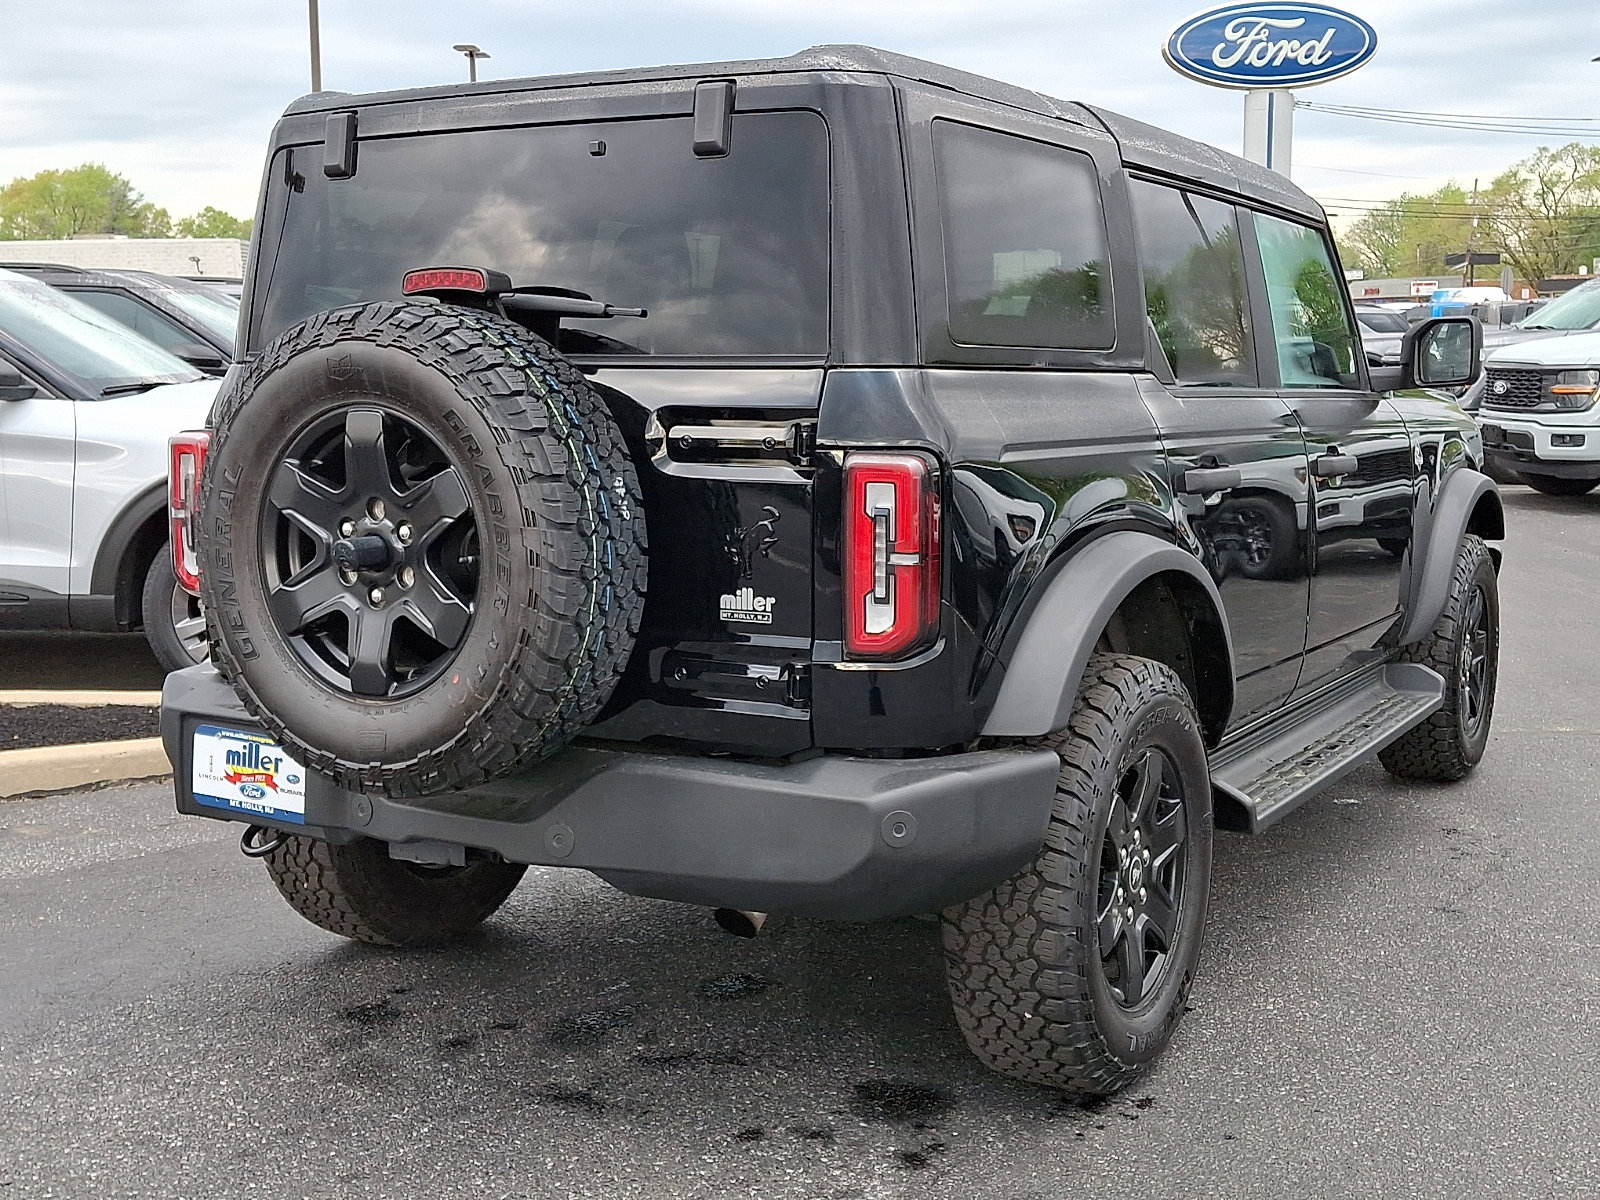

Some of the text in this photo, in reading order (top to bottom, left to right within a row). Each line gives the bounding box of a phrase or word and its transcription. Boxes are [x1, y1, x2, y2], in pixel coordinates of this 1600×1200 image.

[1212, 17, 1337, 68] Ford
[442, 408, 512, 617] GRABBER
[215, 463, 260, 661] GENERAL
[720, 587, 776, 612] miller
[226, 742, 283, 774] miller
[198, 773, 224, 782] LINCOLN
[243, 784, 262, 798] Ford
